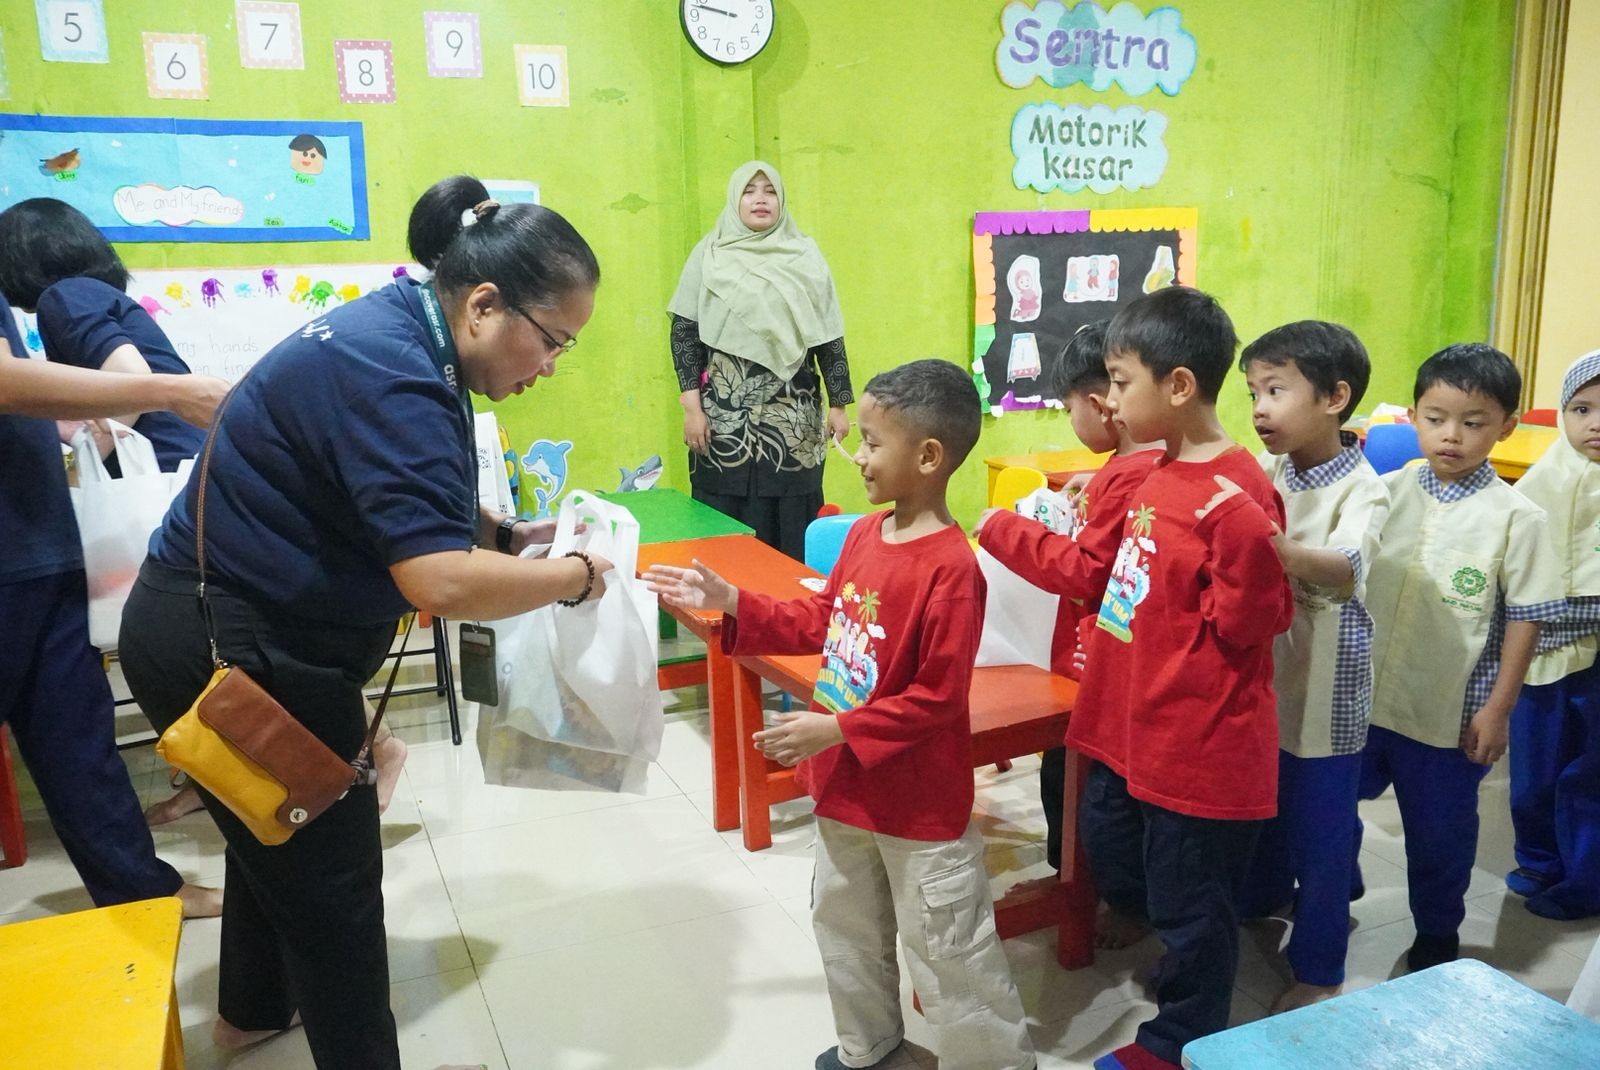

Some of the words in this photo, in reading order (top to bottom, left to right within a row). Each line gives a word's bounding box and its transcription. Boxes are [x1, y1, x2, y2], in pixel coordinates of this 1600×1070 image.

[690, 9, 700, 22] 9
[755, 5, 764, 19] 3
[63, 12, 83, 43] 5
[258, 22, 281, 51] 7
[698, 26, 707, 39] 8
[751, 23, 760, 36] 4
[444, 30, 464, 58] 9
[713, 38, 721, 52] 7
[726, 42, 736, 56] 6
[740, 36, 750, 50] 5
[1009, 18, 1170, 71] Sentra
[166, 49, 187, 80] 6
[358, 59, 375, 87] 8
[528, 63, 557, 90] 10
[117, 190, 145, 213] Me
[153, 195, 177, 210] and
[180, 191, 199, 214] My
[177, 342, 196, 357] my
[208, 333, 258, 352] hands
